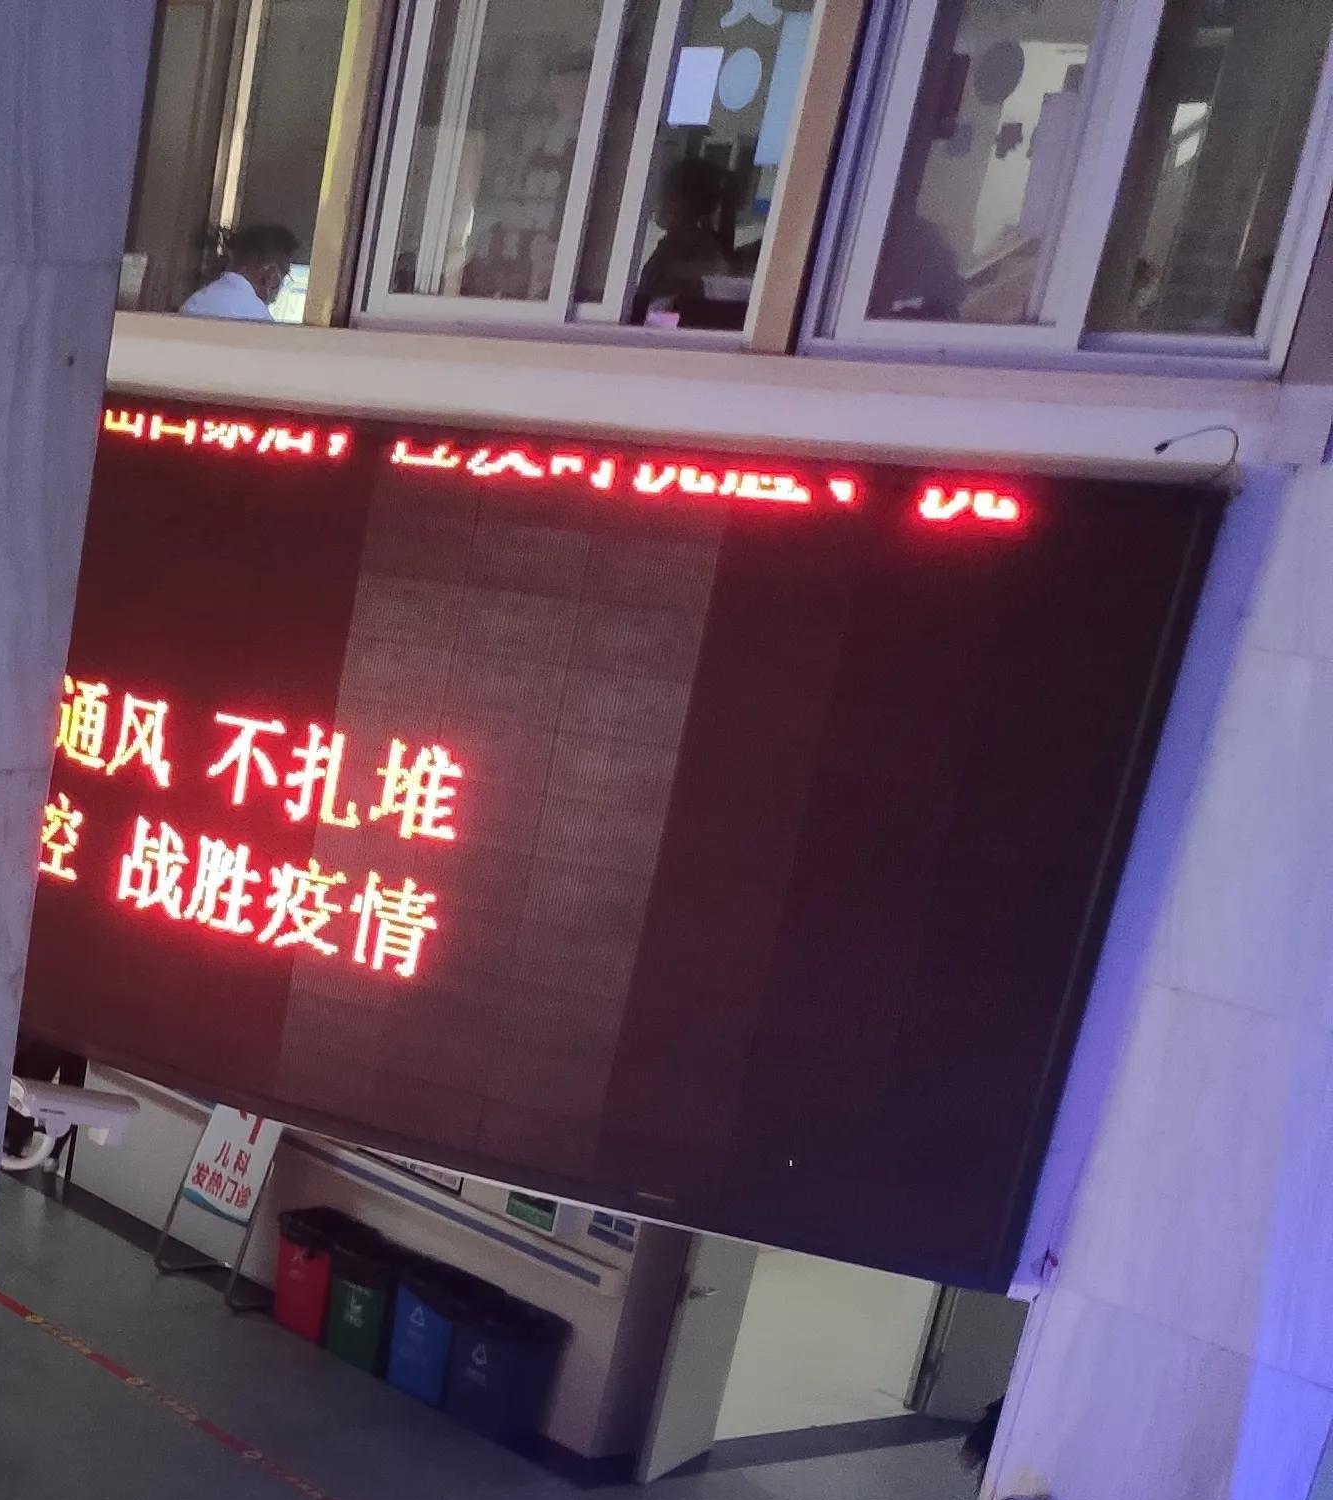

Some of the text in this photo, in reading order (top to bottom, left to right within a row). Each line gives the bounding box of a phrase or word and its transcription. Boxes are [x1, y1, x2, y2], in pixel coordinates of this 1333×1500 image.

[54, 676, 464, 840] 通风 不扎堆
[117, 815, 436, 978] 战胜疫情
[192, 1161, 252, 1208] 发热门诊
[215, 1139, 252, 1177] 儿科
